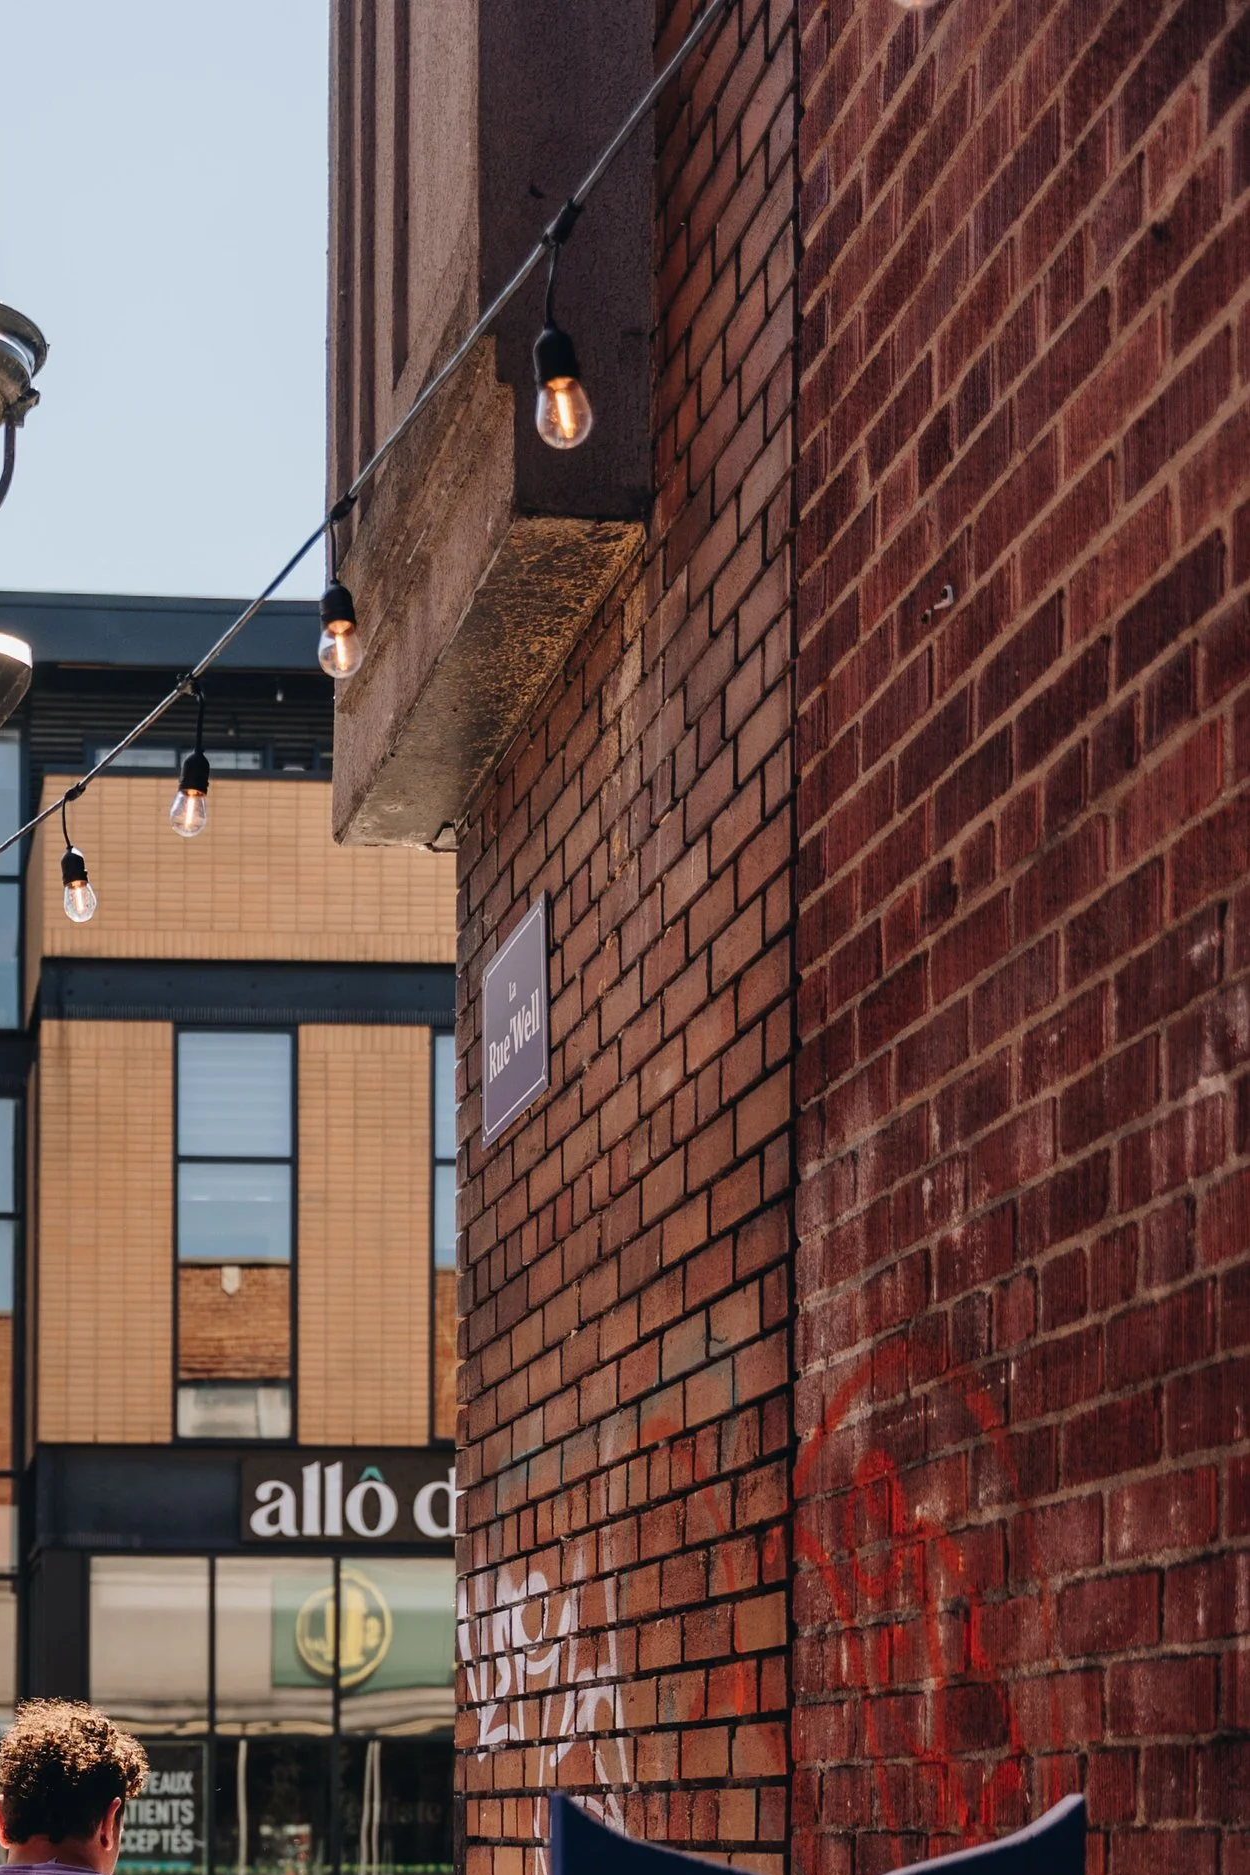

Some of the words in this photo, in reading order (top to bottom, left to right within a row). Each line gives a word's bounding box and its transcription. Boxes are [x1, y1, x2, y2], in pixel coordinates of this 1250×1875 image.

[508, 981, 517, 1002] La
[250, 1460, 399, 1538] allô
[143, 1770, 195, 1795] EAUX
